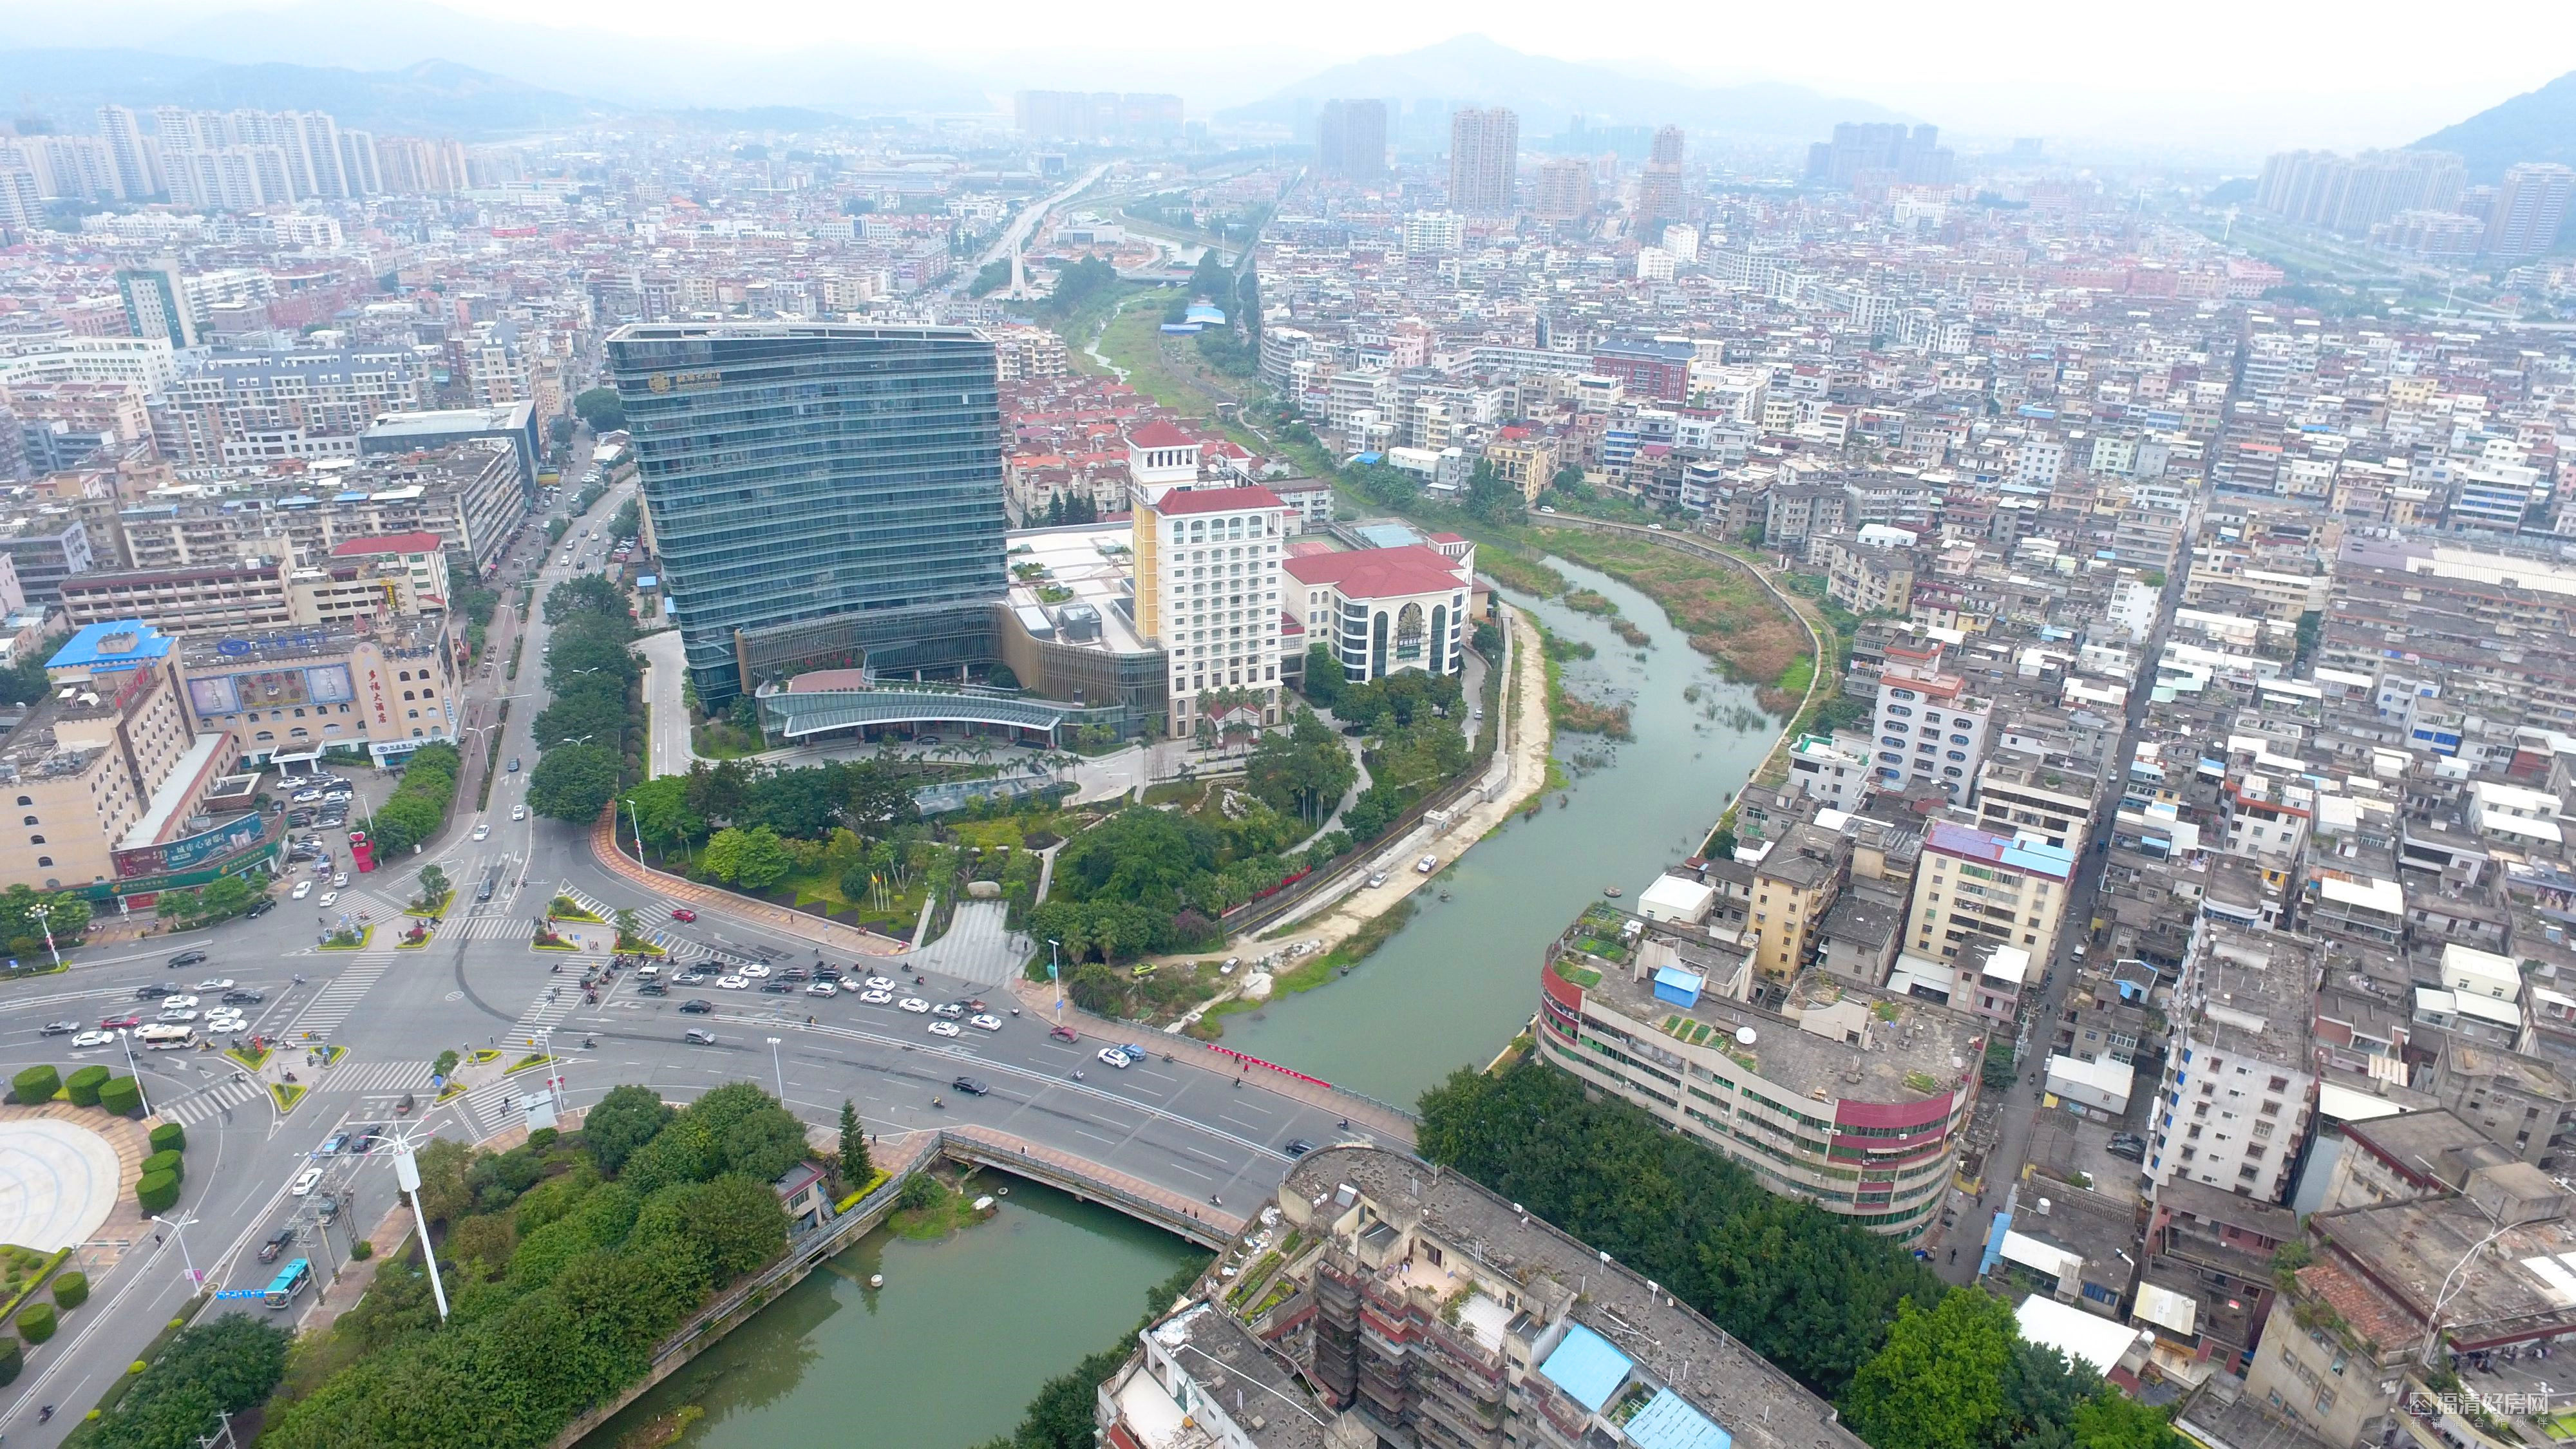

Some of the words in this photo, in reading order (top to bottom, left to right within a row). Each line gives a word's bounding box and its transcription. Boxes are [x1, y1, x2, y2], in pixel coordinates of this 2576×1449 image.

[368, 669, 387, 724] 多福大酒店
